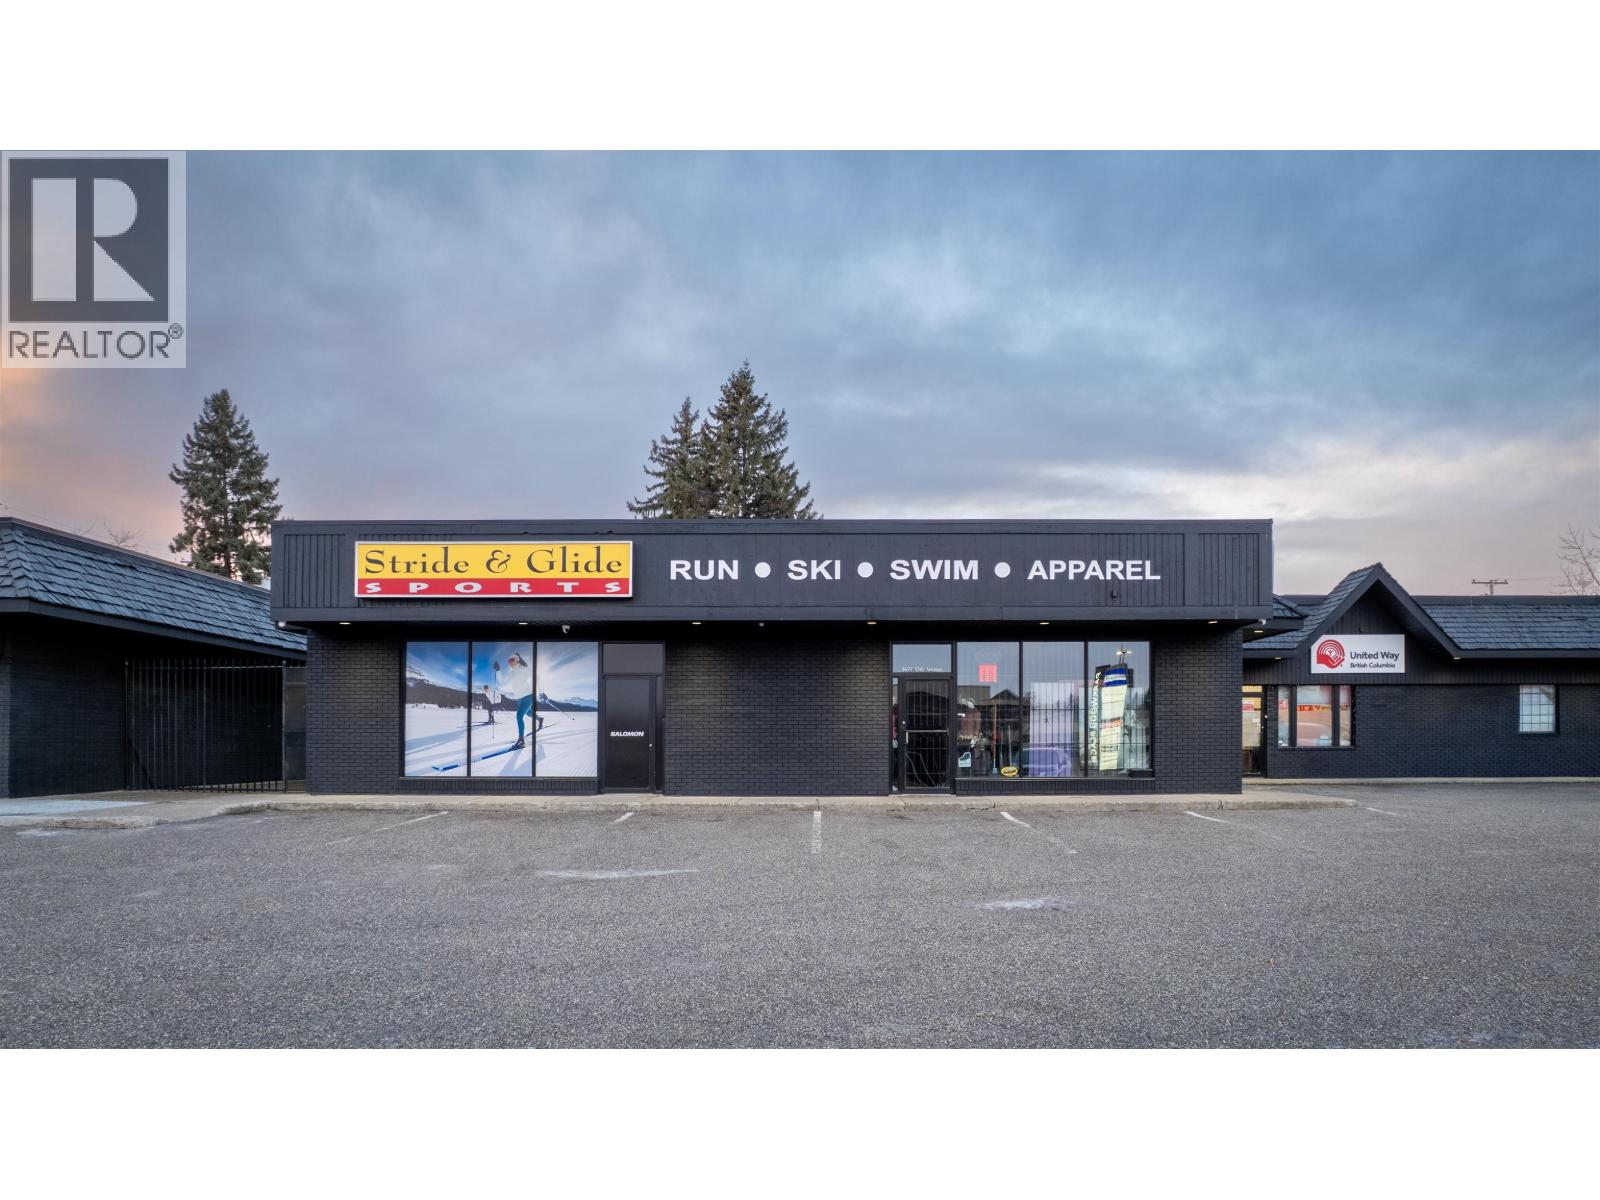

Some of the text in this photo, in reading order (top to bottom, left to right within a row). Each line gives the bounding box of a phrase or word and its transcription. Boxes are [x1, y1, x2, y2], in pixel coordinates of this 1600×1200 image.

[365, 546, 622, 574] Stride & Glide
[669, 559, 1162, 581] RUN SKI SWIM APPAREL
[1350, 651, 1400, 662] United Way
